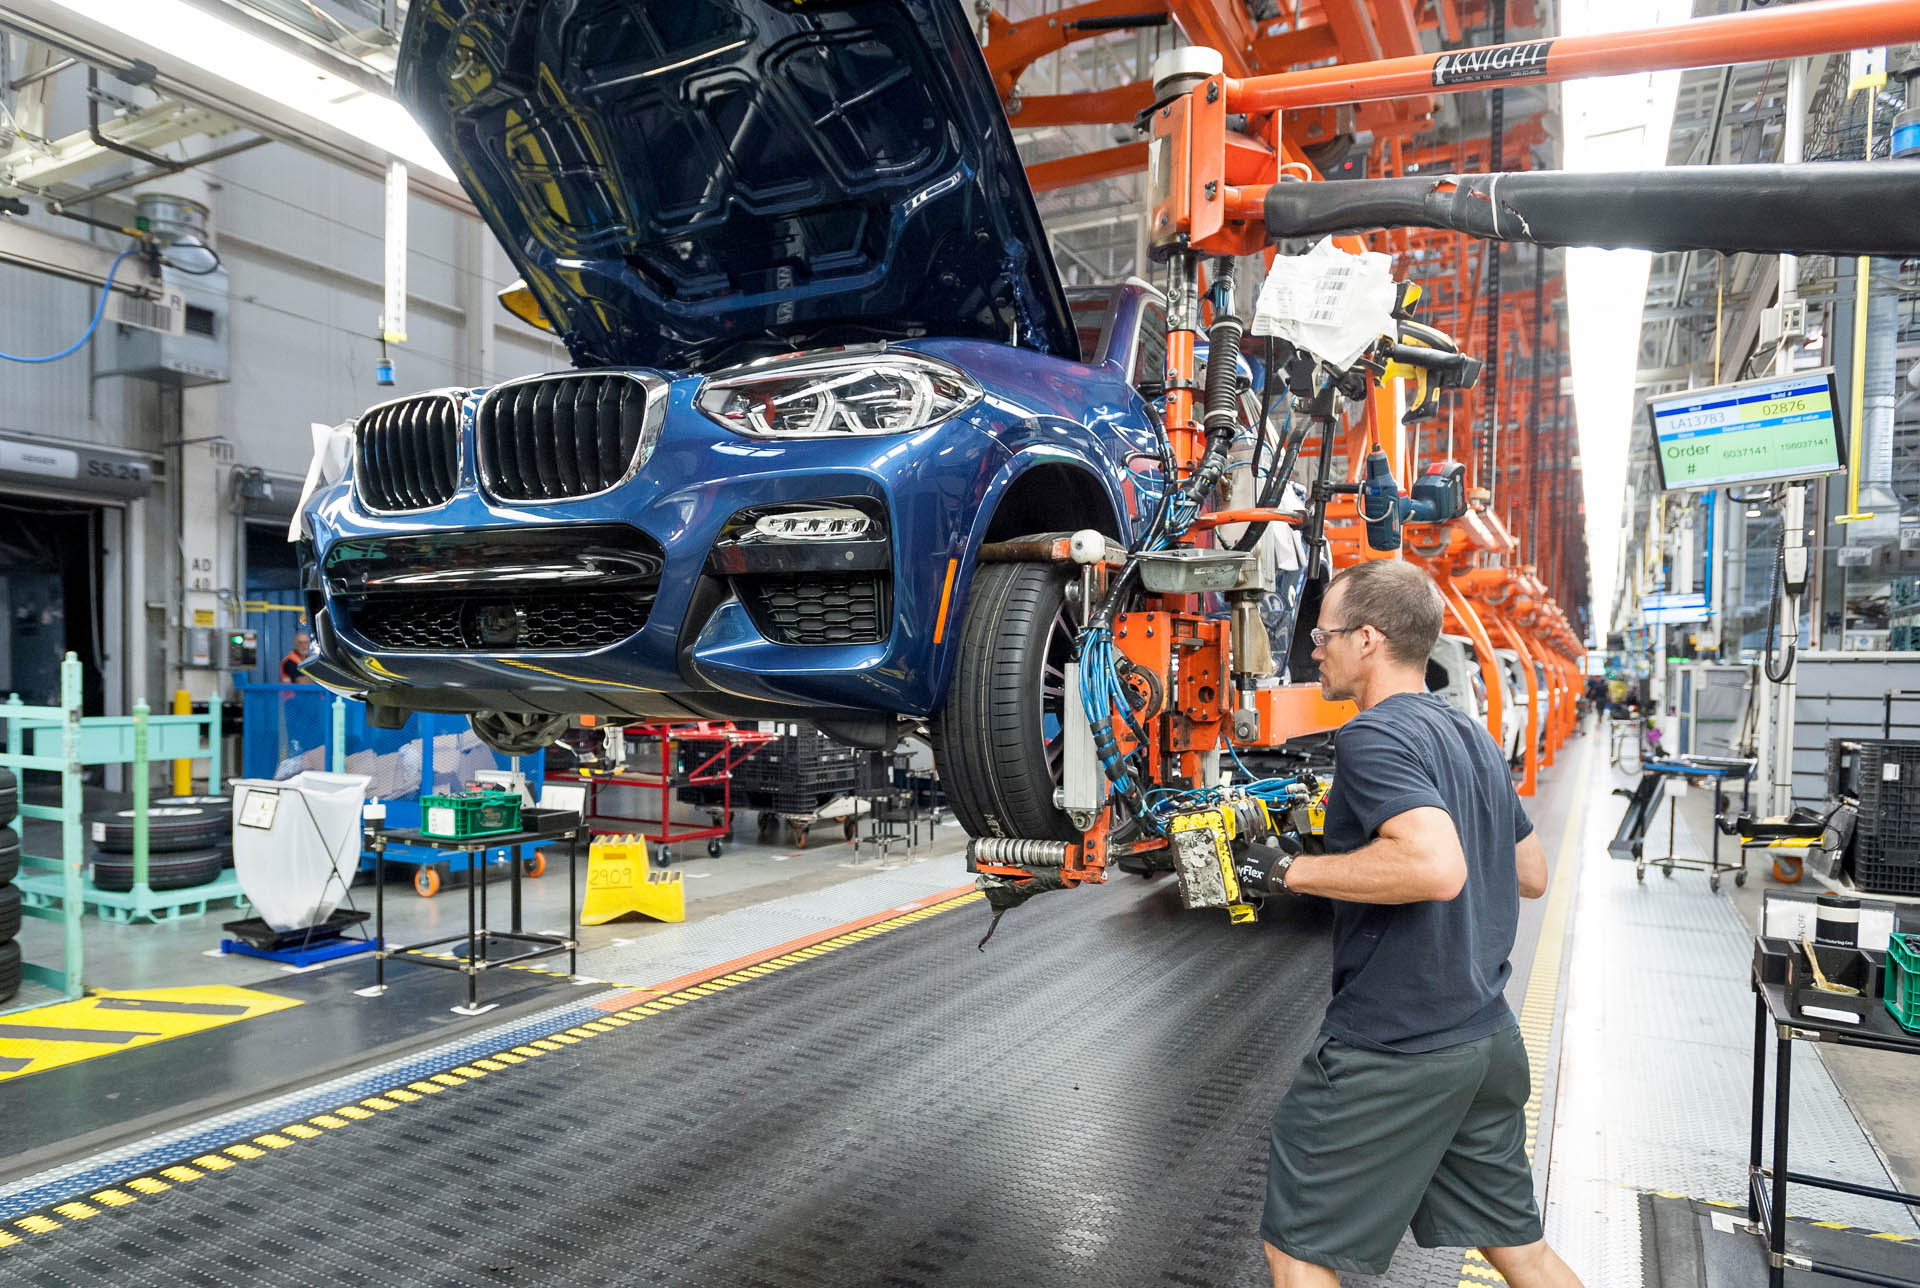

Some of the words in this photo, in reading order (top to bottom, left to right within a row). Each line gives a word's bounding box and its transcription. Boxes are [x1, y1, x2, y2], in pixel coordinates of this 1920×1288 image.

[1451, 43, 1547, 74] KNIGHT
[1762, 400, 1806, 416] 02876
[1670, 412, 1726, 431] LA13783
[1667, 443, 1711, 459] Order
[1687, 463, 1696, 475] #
